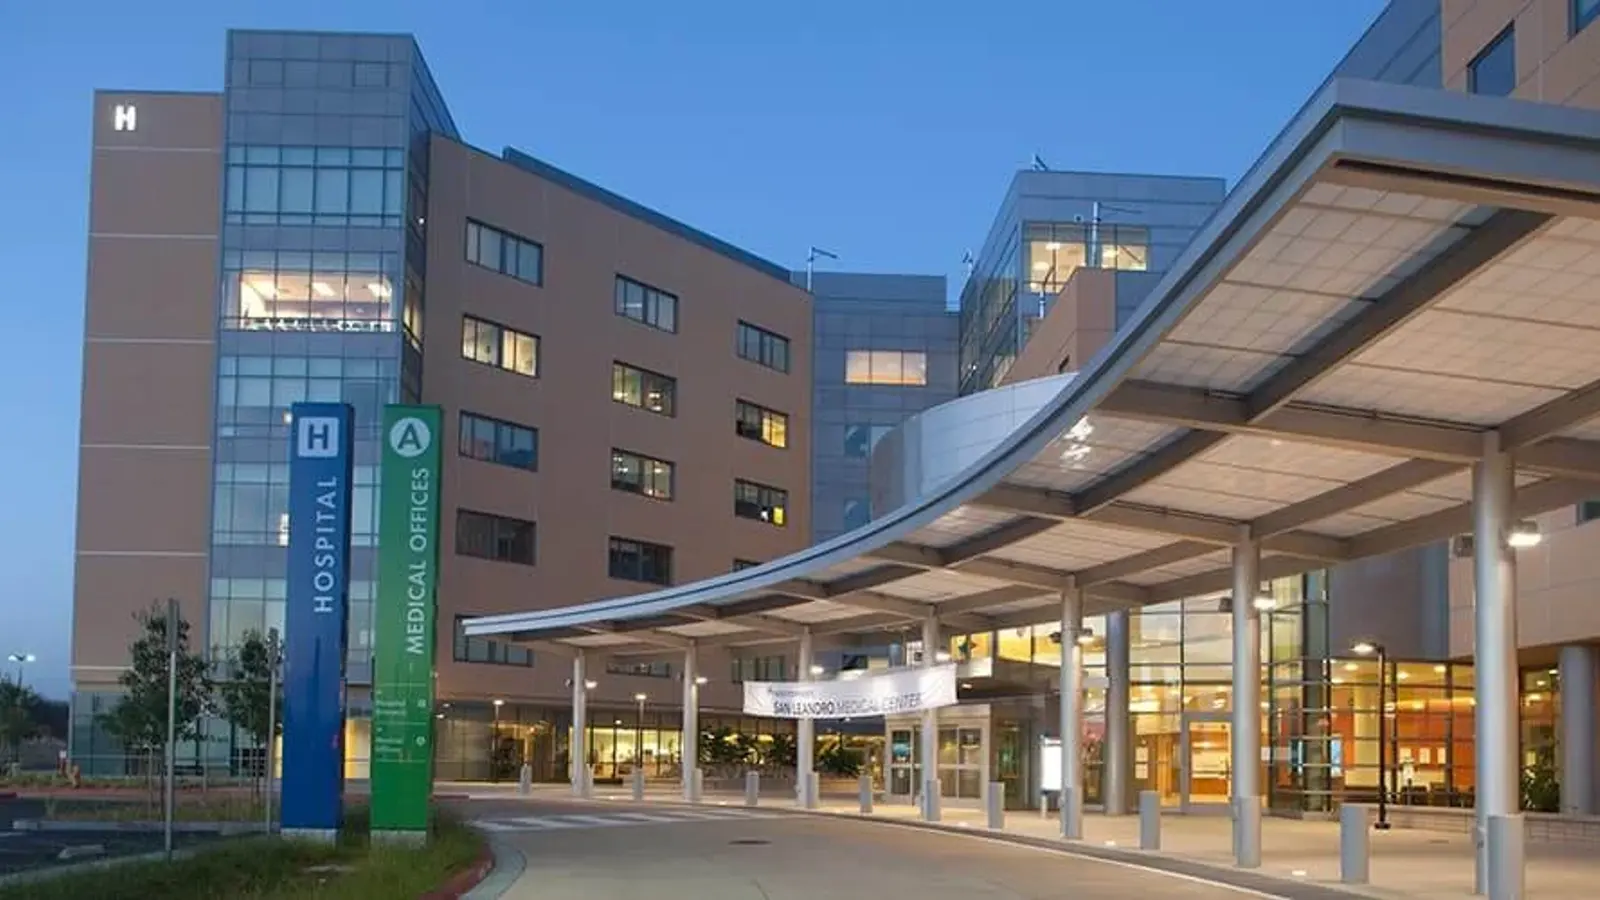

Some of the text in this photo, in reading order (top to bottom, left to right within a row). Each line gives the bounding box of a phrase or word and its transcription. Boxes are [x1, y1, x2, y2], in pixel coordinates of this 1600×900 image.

[115, 105, 136, 131] H
[308, 424, 329, 451] H
[398, 423, 422, 450] A
[314, 476, 337, 613] HOSPITAL
[406, 468, 429, 655] MEDICAL OFFICES
[773, 693, 922, 715] SAN LEANDRO MEDICAL CENTER
